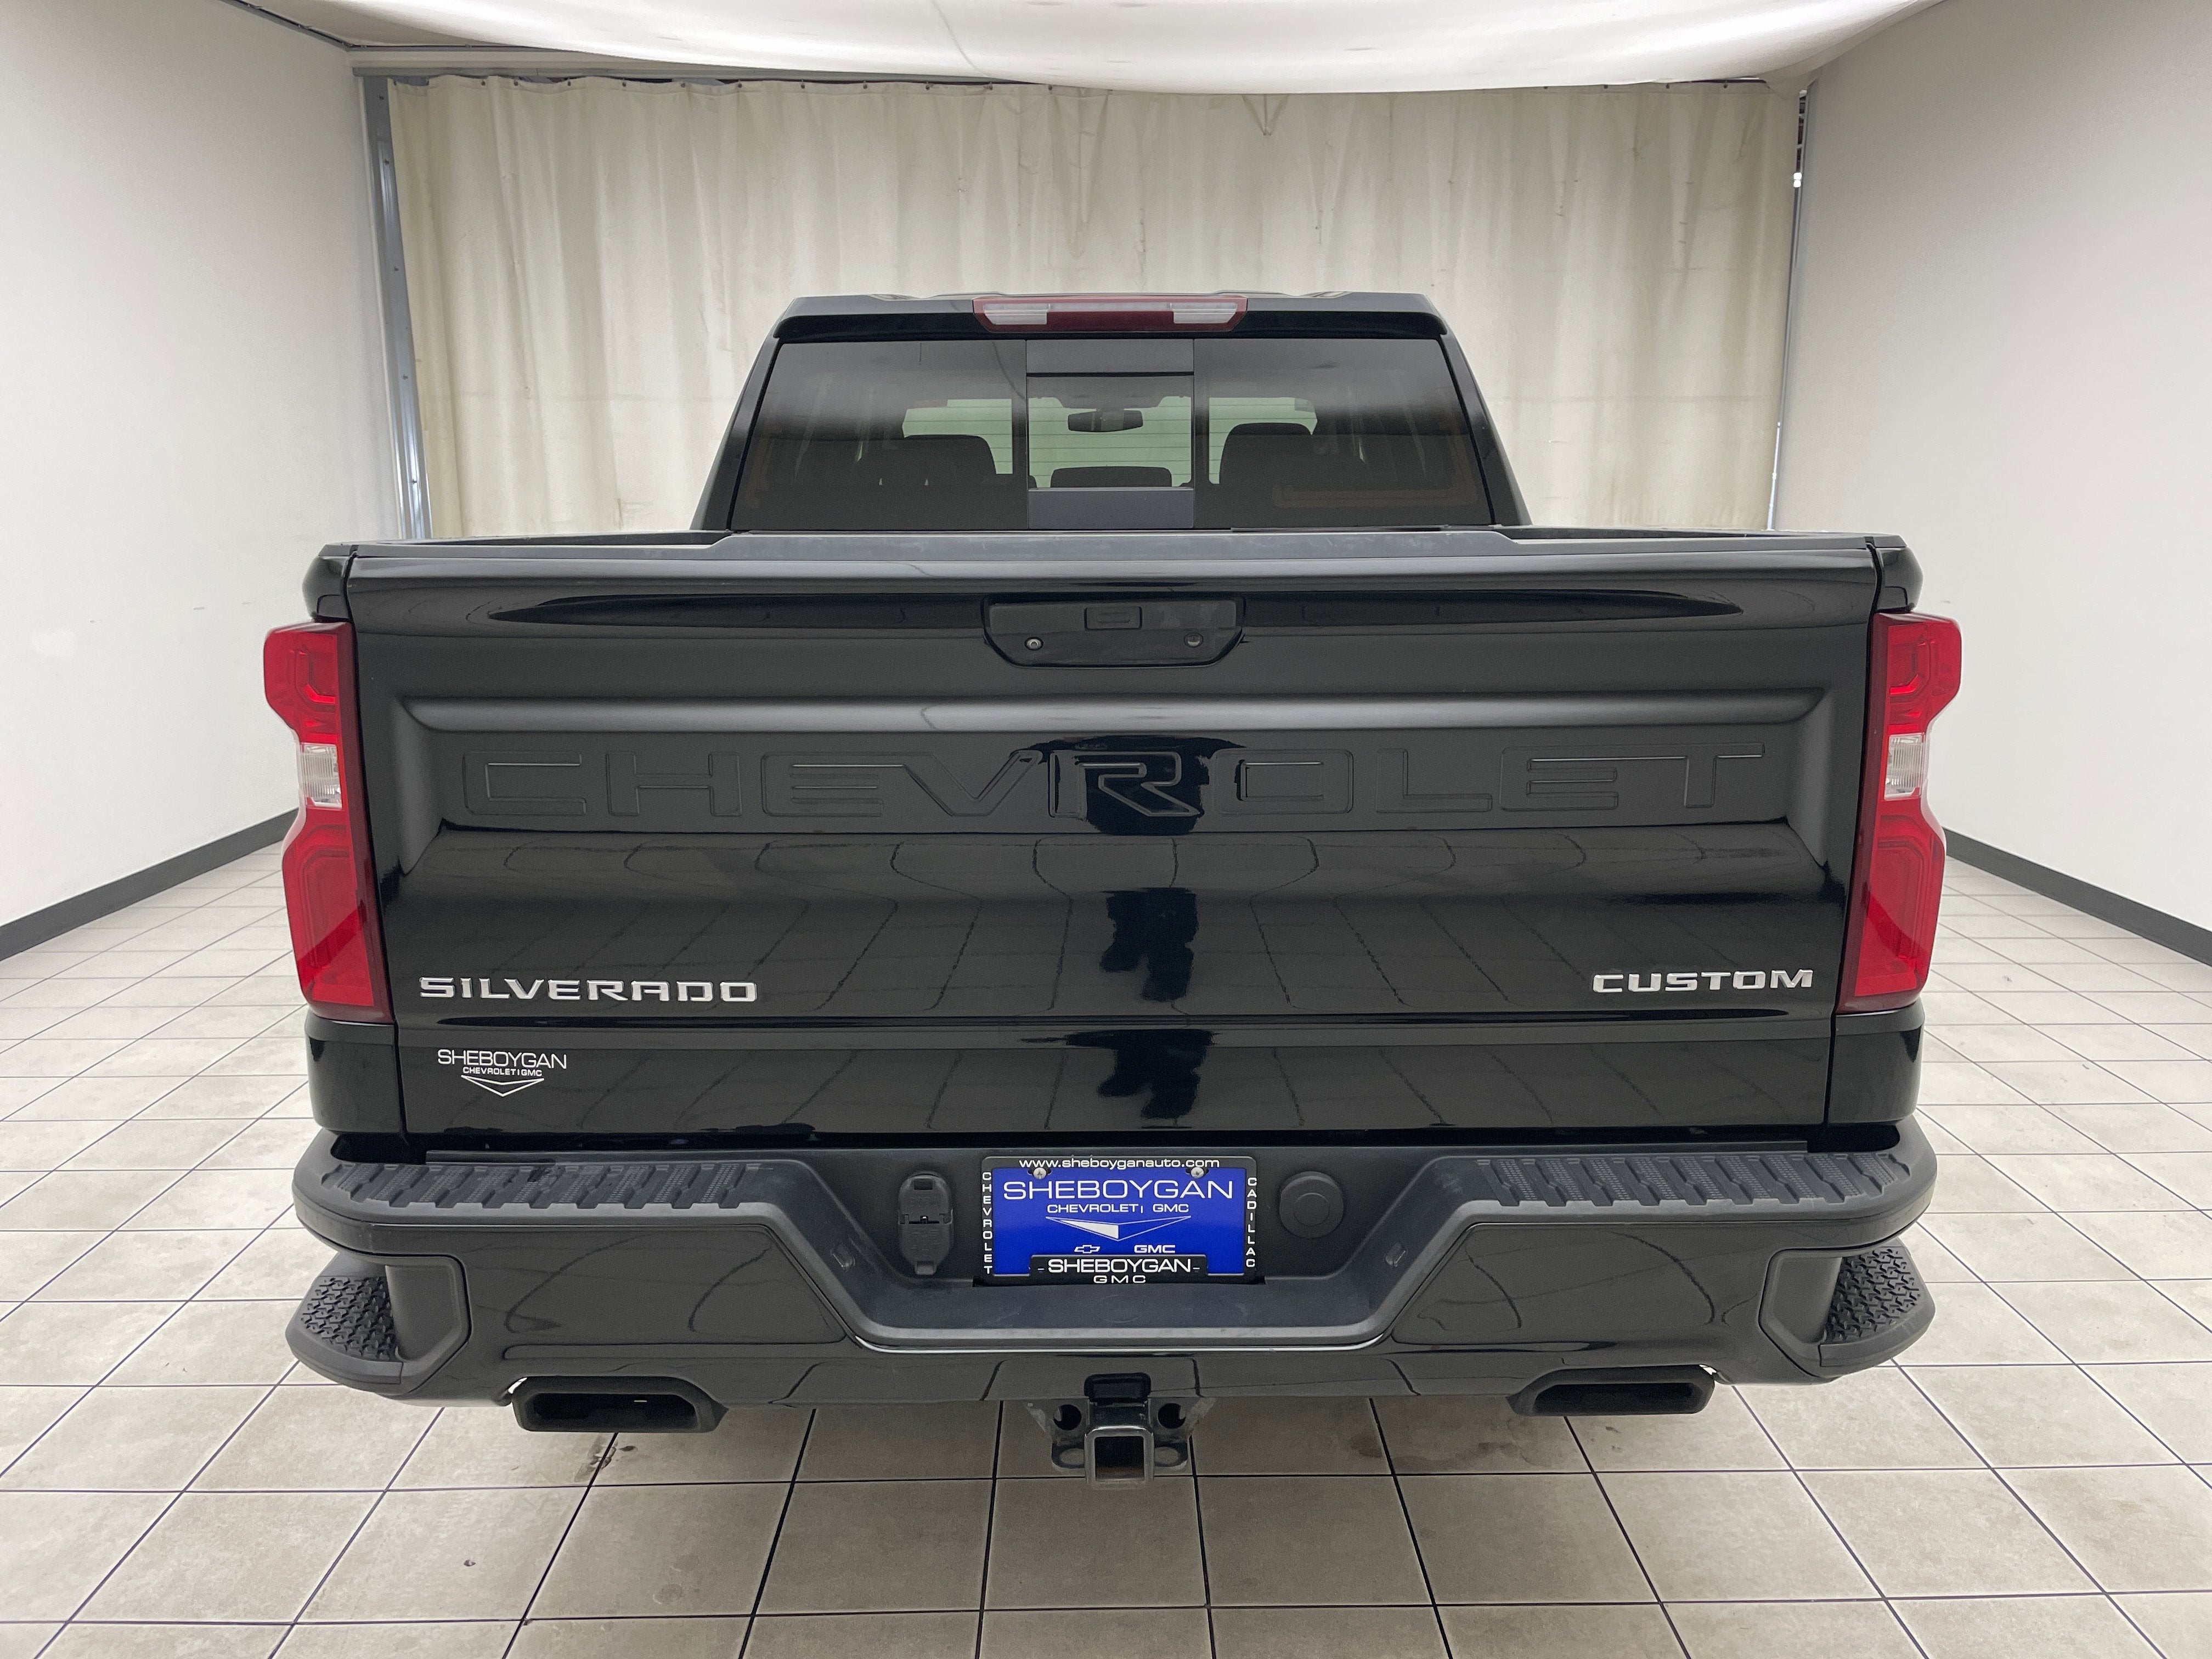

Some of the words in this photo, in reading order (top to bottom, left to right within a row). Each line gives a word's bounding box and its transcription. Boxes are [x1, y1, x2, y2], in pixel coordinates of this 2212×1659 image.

[462, 742, 1765, 819] CHEVROLET
[420, 977, 757, 1002] SILVERADO
[1592, 969, 1814, 993] CUSTOM
[437, 1049, 567, 1069] SHEBOYGAN
[1019, 1158, 1220, 1170] www.sheboyganauto.com
[1003, 1180, 1233, 1200] SHEBOYGAN
[1047, 1204, 1138, 1213] CHEVROLET
[1152, 1203, 1189, 1213] GMC
[981, 1172, 993, 1275] CHEVROLET
[1246, 1177, 1257, 1268] CADILLAC
[1133, 1244, 1176, 1254] GMC
[1048, 1258, 1191, 1273] SHEBOYGAN
[1093, 1274, 1147, 1284] GMC
